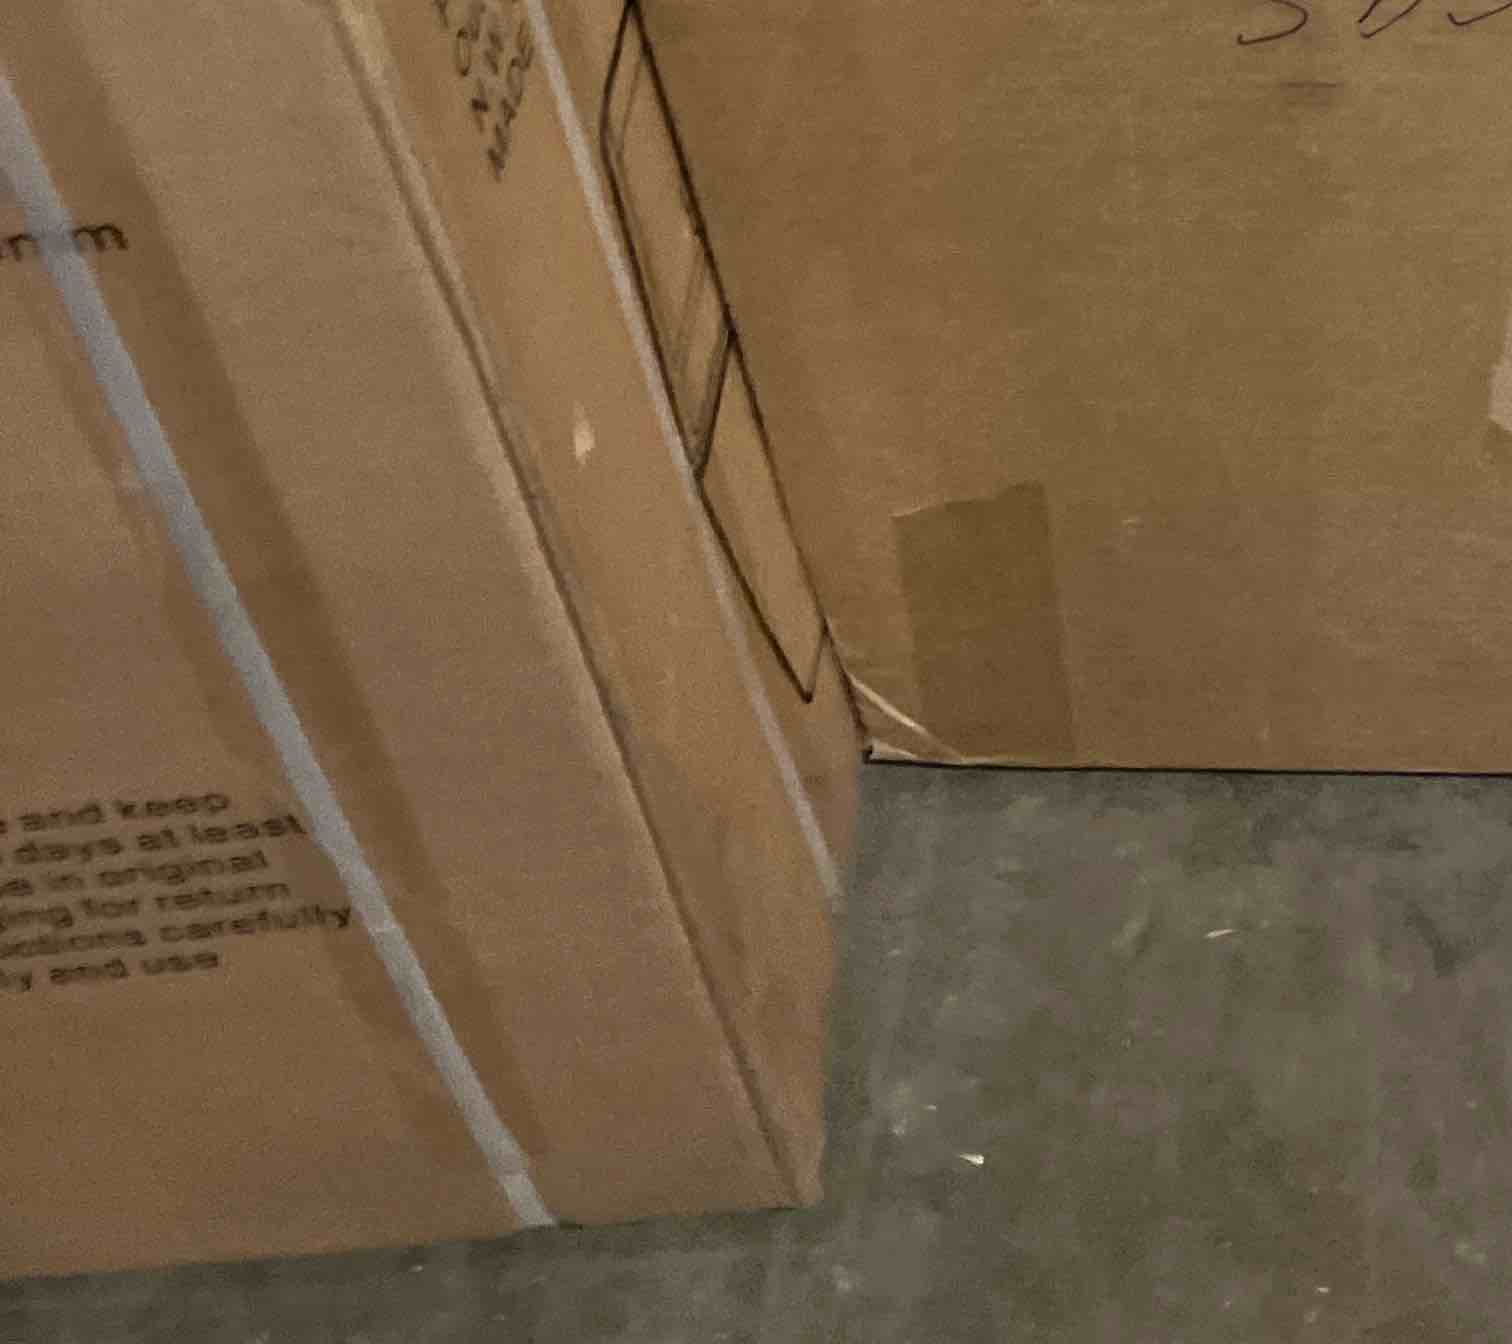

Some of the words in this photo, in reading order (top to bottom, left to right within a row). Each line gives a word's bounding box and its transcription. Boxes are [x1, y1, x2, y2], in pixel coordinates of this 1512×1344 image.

[18, 801, 105, 832] and
[14, 835, 123, 865] days
[136, 827, 181, 852] at
[188, 813, 307, 844] least
[97, 849, 269, 886] original
[153, 882, 293, 912] return
[158, 903, 352, 944] carefully
[48, 958, 130, 986] and
[140, 950, 220, 978] use
